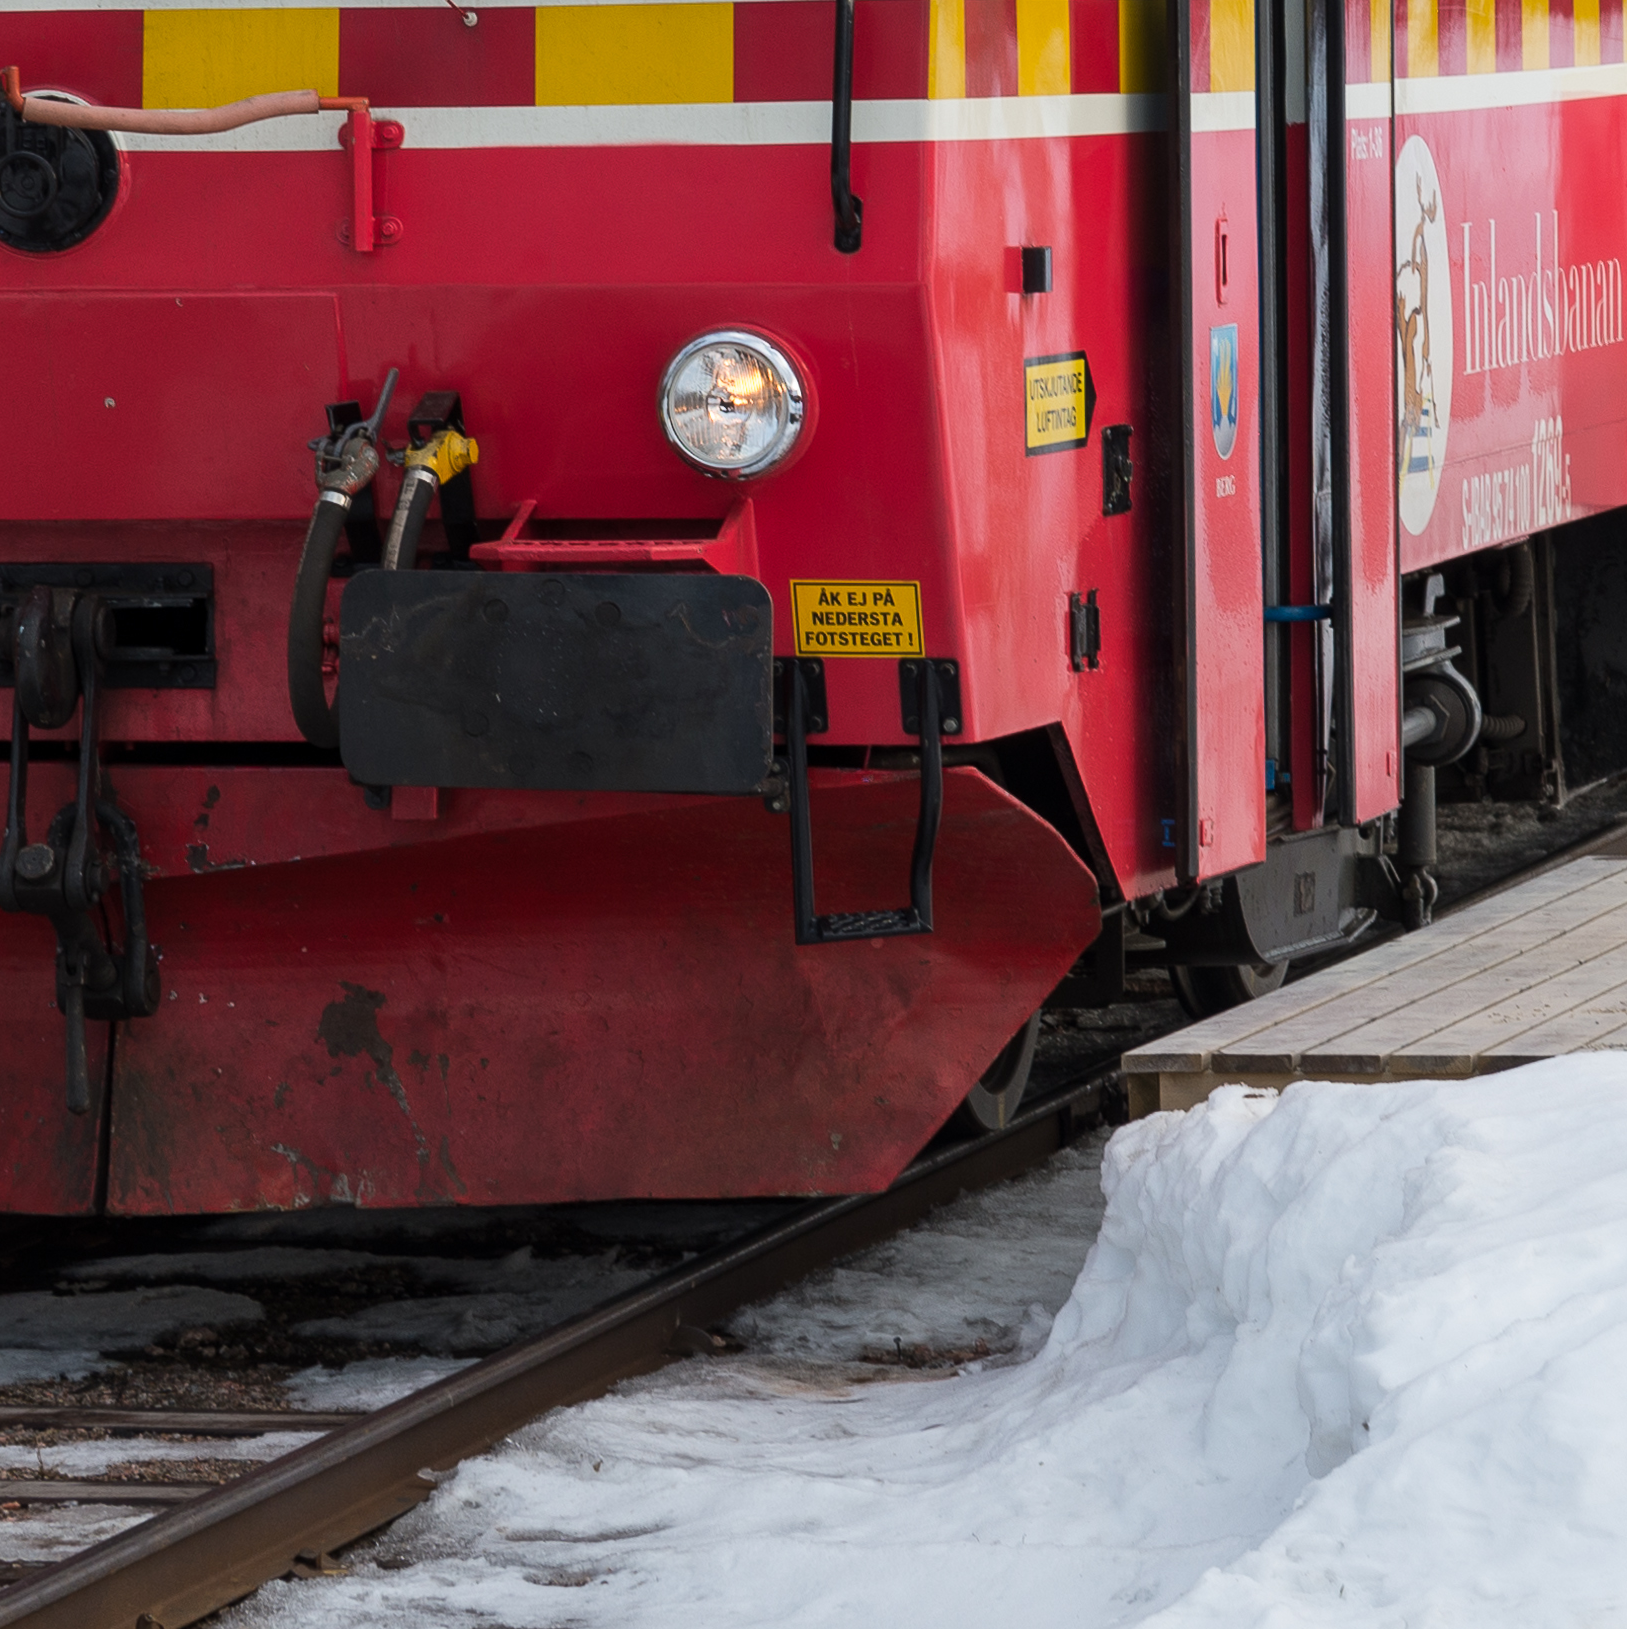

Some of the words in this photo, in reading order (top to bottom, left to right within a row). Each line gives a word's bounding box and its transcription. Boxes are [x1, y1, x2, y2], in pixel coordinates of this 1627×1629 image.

[1461, 209, 1624, 376] Inlandsbanan
[1029, 372, 1082, 401] UTSKJUTANDE
[1036, 406, 1077, 432] LUFTINTAG
[818, 587, 842, 607] ÅK
[847, 591, 867, 607] EJ
[872, 588, 895, 607] PÅ
[812, 611, 903, 626] NEDERSTA
[805, 631, 903, 647] FOTSTEGET
